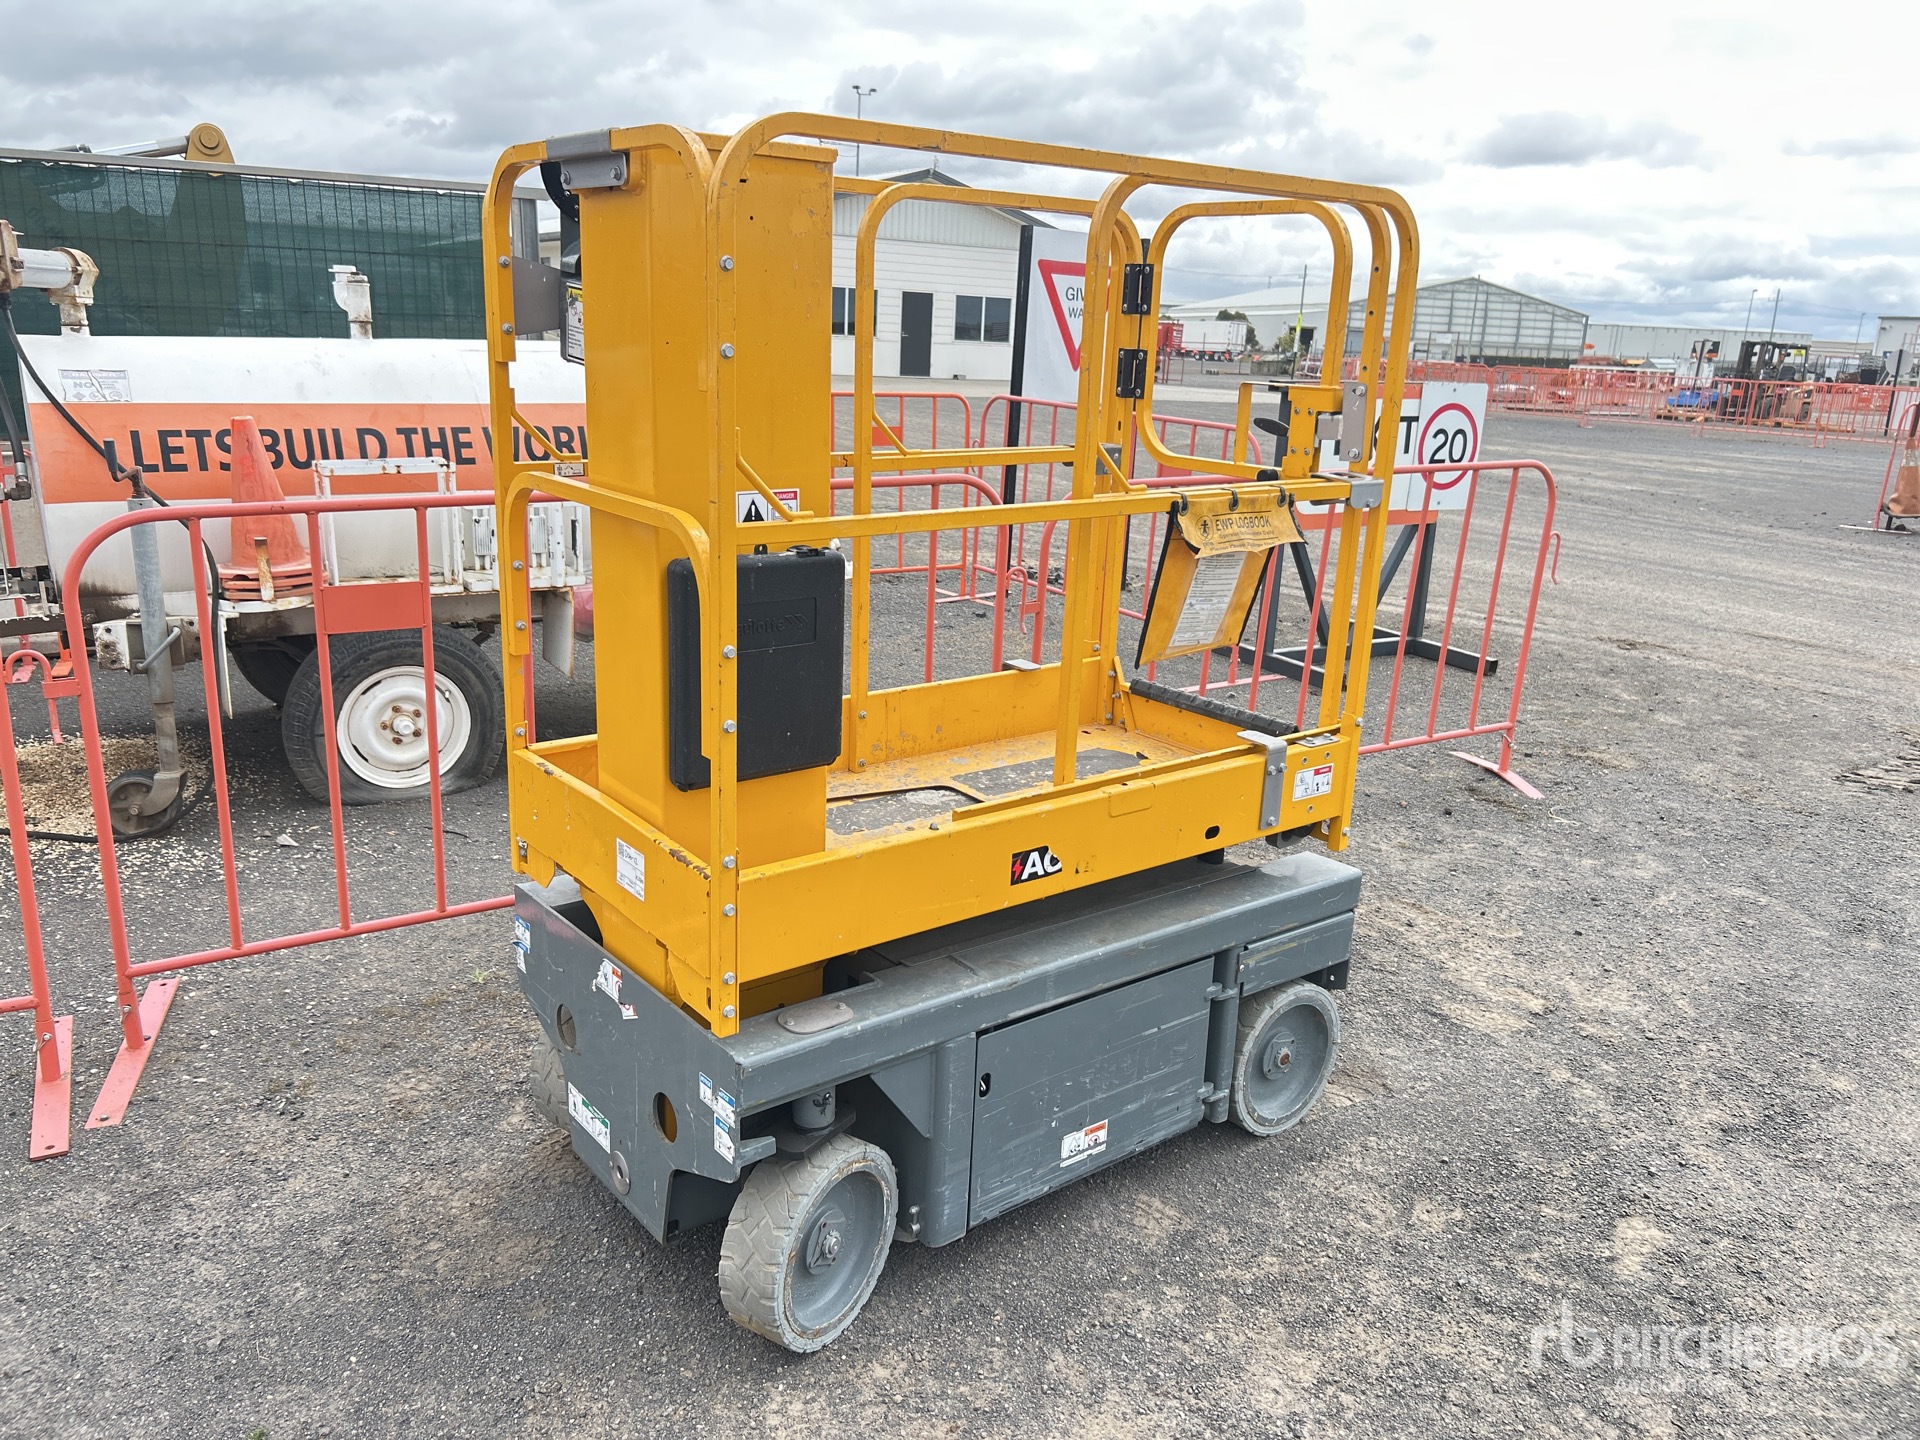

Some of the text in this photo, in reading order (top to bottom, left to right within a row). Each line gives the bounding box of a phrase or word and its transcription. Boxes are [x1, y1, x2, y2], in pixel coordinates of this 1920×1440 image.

[129, 428, 231, 473] LETS
[258, 428, 388, 470] BUILD
[395, 426, 477, 466] THE
[1428, 427, 1468, 464] 20
[1215, 515, 1272, 531] EWP LOGBOOK
